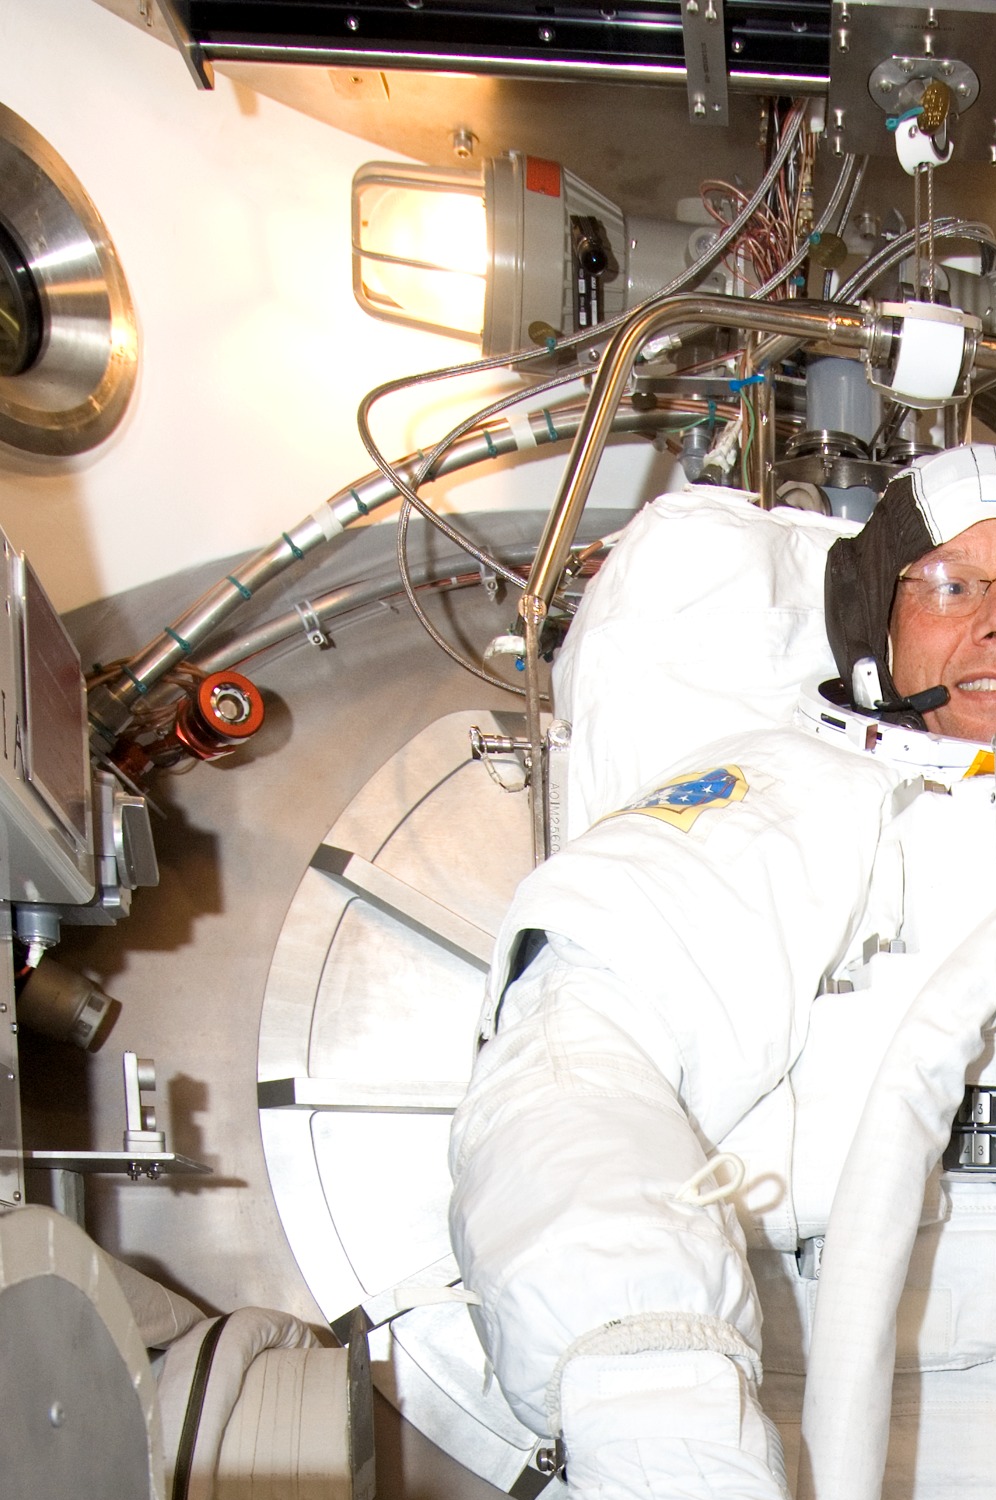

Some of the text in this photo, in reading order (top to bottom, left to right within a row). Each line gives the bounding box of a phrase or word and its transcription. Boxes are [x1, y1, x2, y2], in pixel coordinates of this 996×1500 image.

[977, 1103, 984, 1115] 3
[964, 1145, 984, 1155] 4 3
